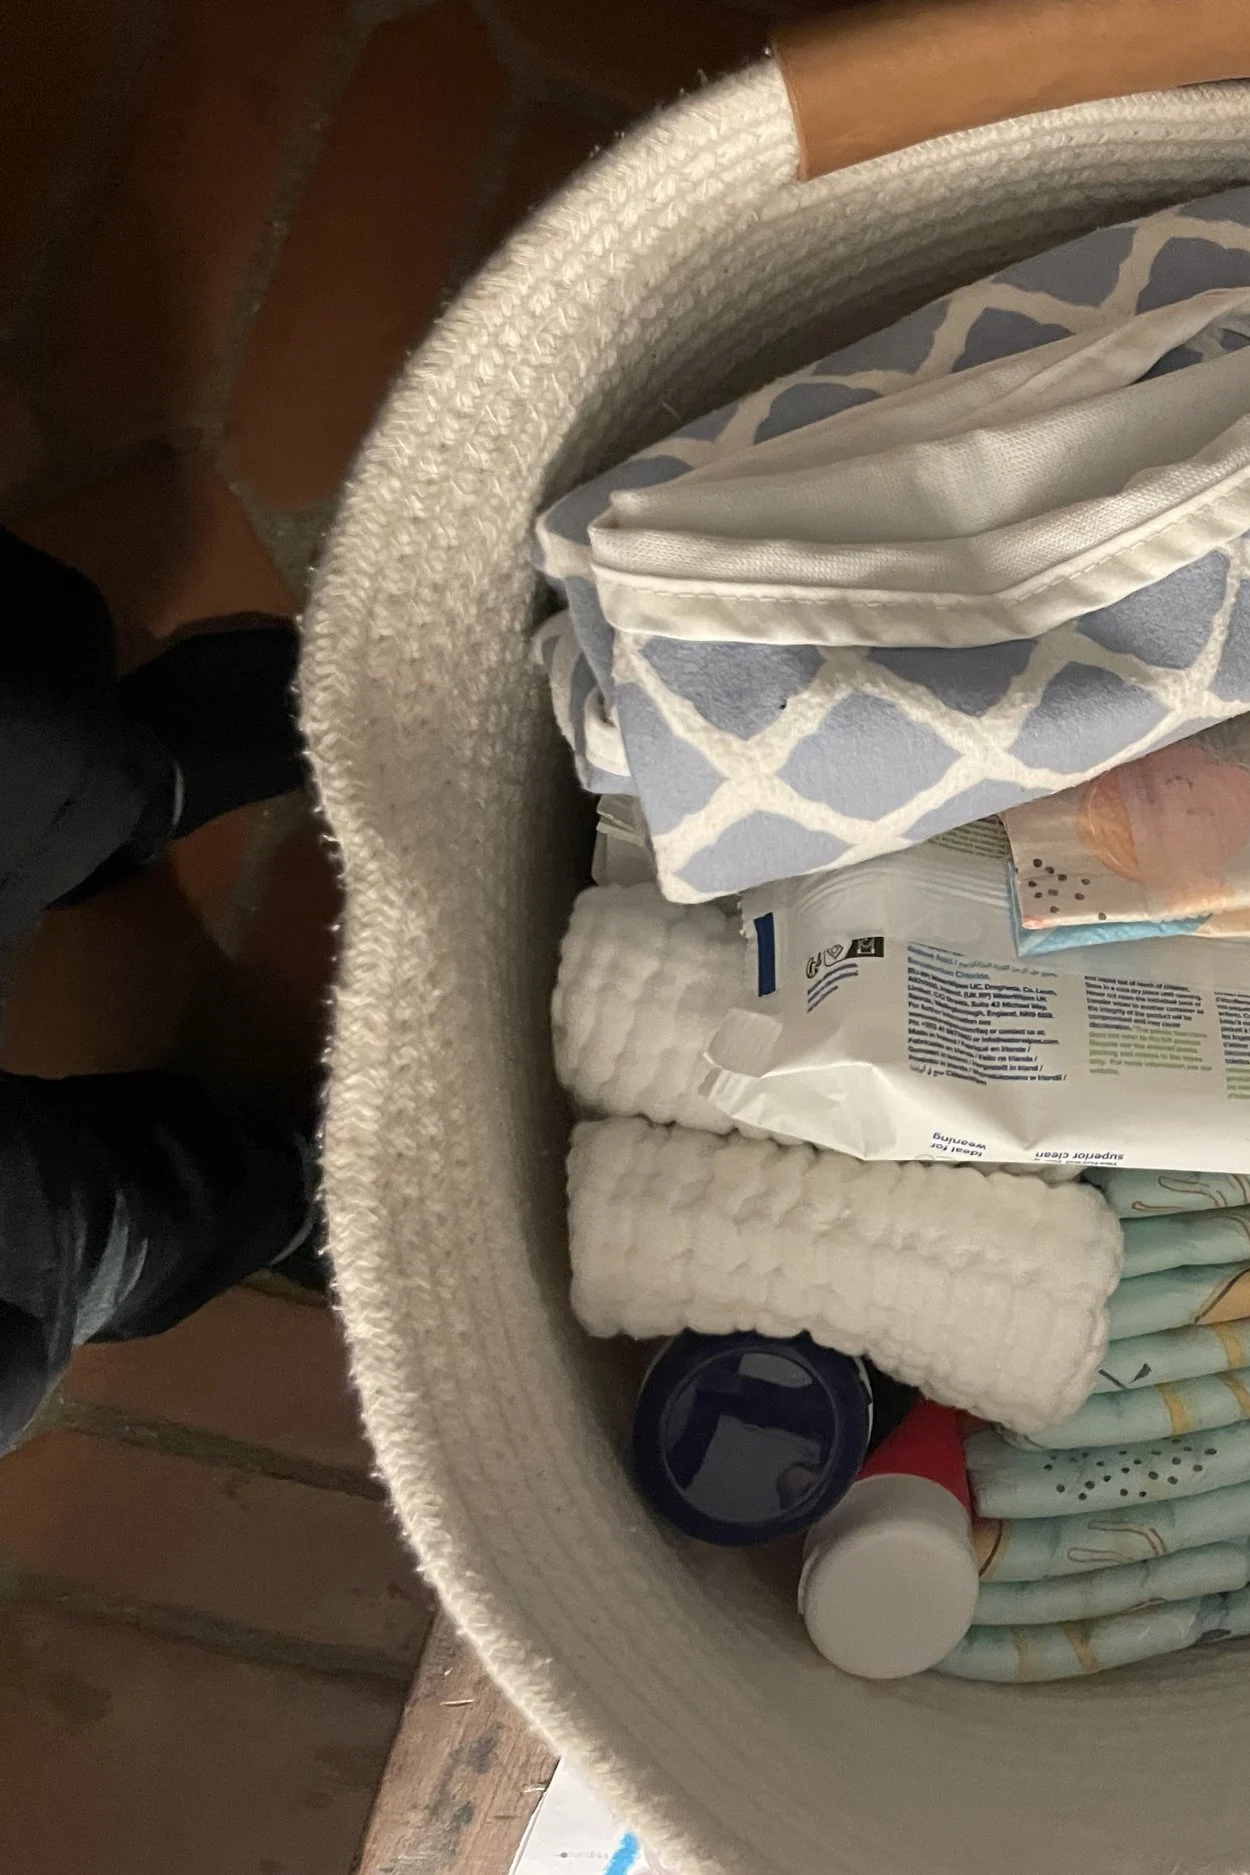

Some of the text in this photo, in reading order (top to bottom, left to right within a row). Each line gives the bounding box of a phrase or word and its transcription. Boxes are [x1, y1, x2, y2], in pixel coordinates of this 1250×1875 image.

[930, 1142, 982, 1158] Ideal for
[932, 1132, 987, 1152] weaning
[1035, 1151, 1124, 1162] superior clean
